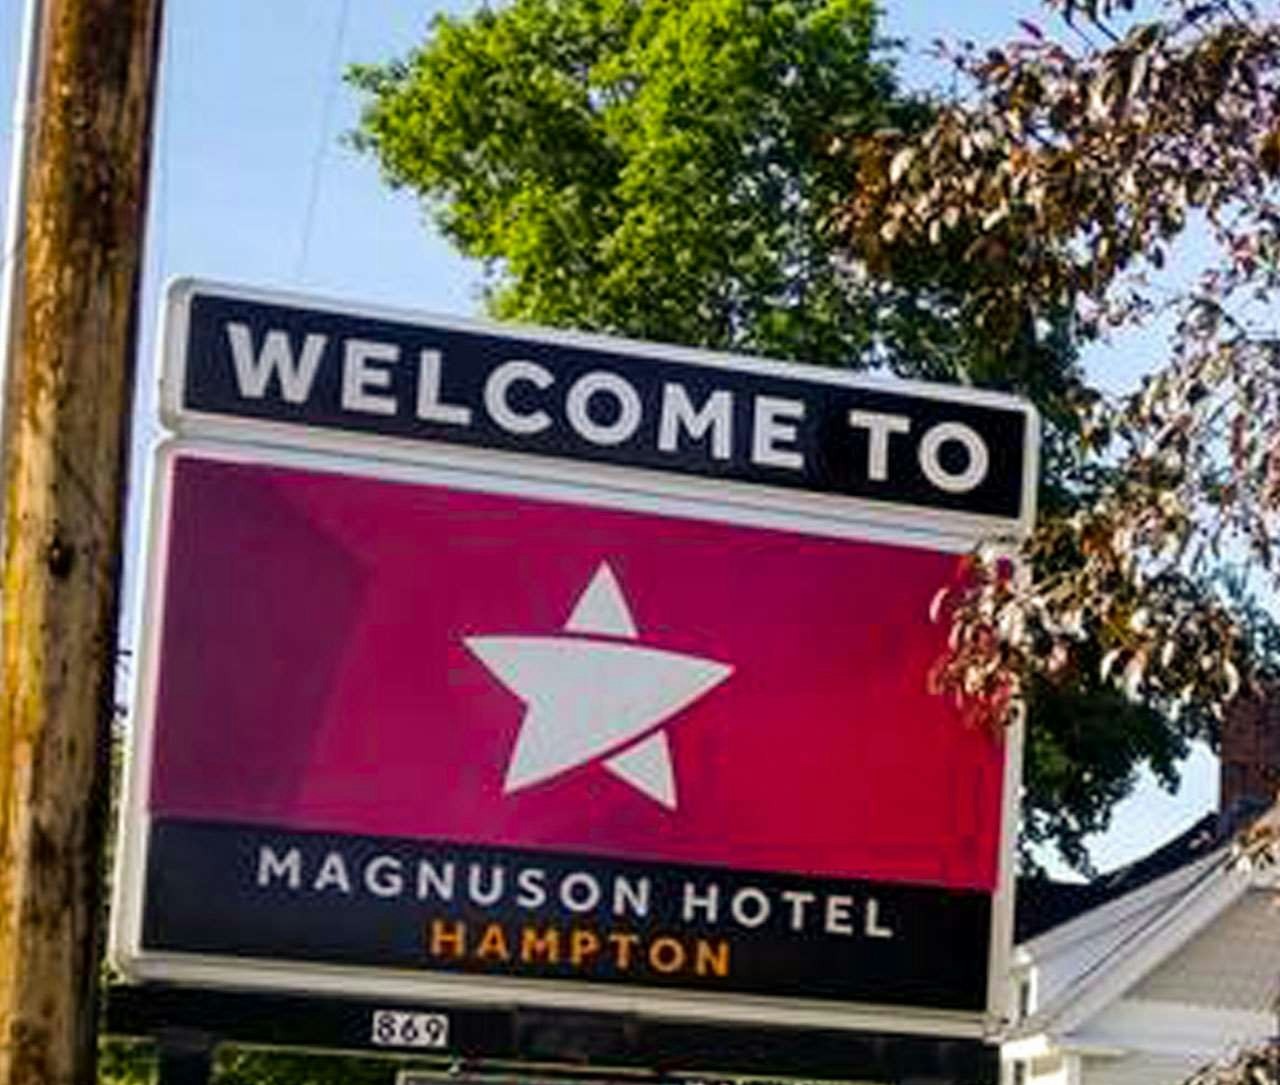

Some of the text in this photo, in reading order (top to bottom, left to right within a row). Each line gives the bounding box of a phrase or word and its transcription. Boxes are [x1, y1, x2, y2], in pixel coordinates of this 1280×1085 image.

[225, 323, 990, 494] WELCOME TO
[255, 847, 894, 940] MAGNUSON HOTEL
[428, 921, 731, 978] HAMPTON
[376, 1013, 446, 1045] 869
